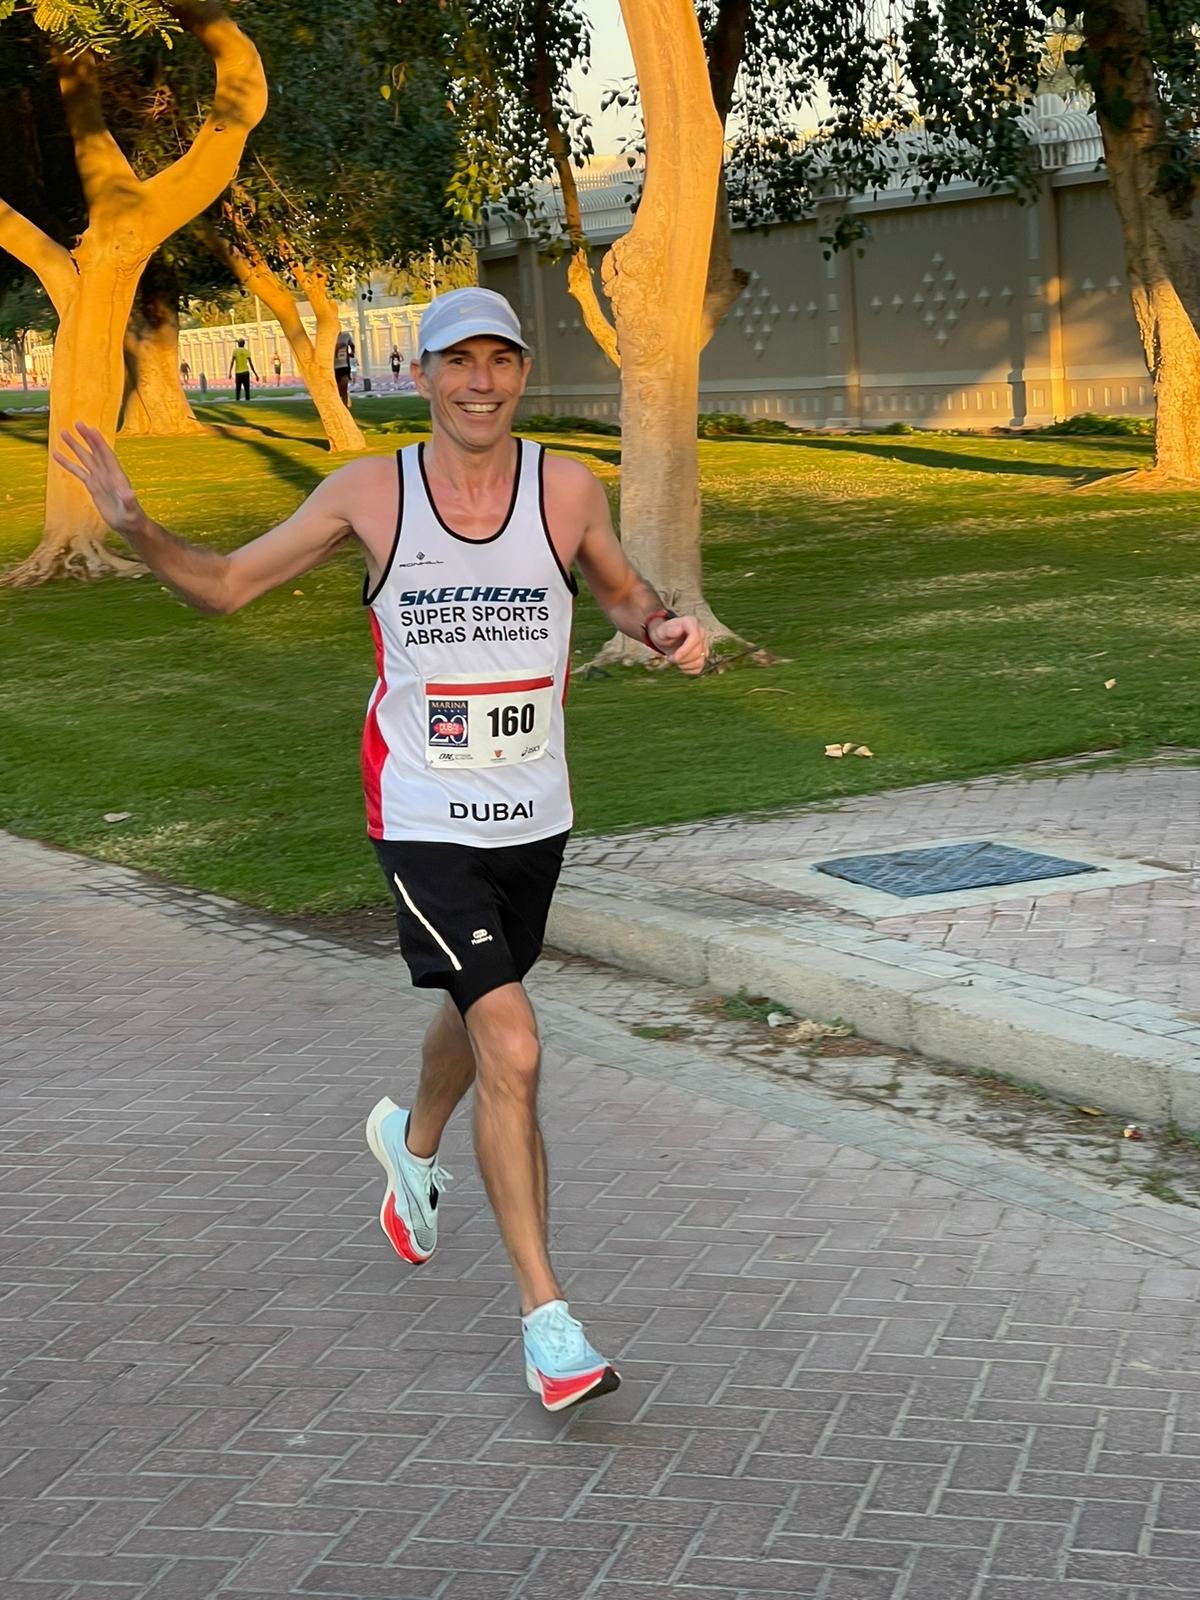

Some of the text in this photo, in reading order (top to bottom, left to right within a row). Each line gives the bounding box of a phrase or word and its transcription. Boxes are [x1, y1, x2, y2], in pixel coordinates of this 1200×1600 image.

[398, 587, 549, 607] SKECHERS
[401, 606, 549, 626] SUPER SPORTS
[405, 626, 549, 647] ABRaS Athletics
[431, 701, 467, 709] MARINA
[486, 703, 535, 737] 160
[449, 800, 533, 822] DUBAI
